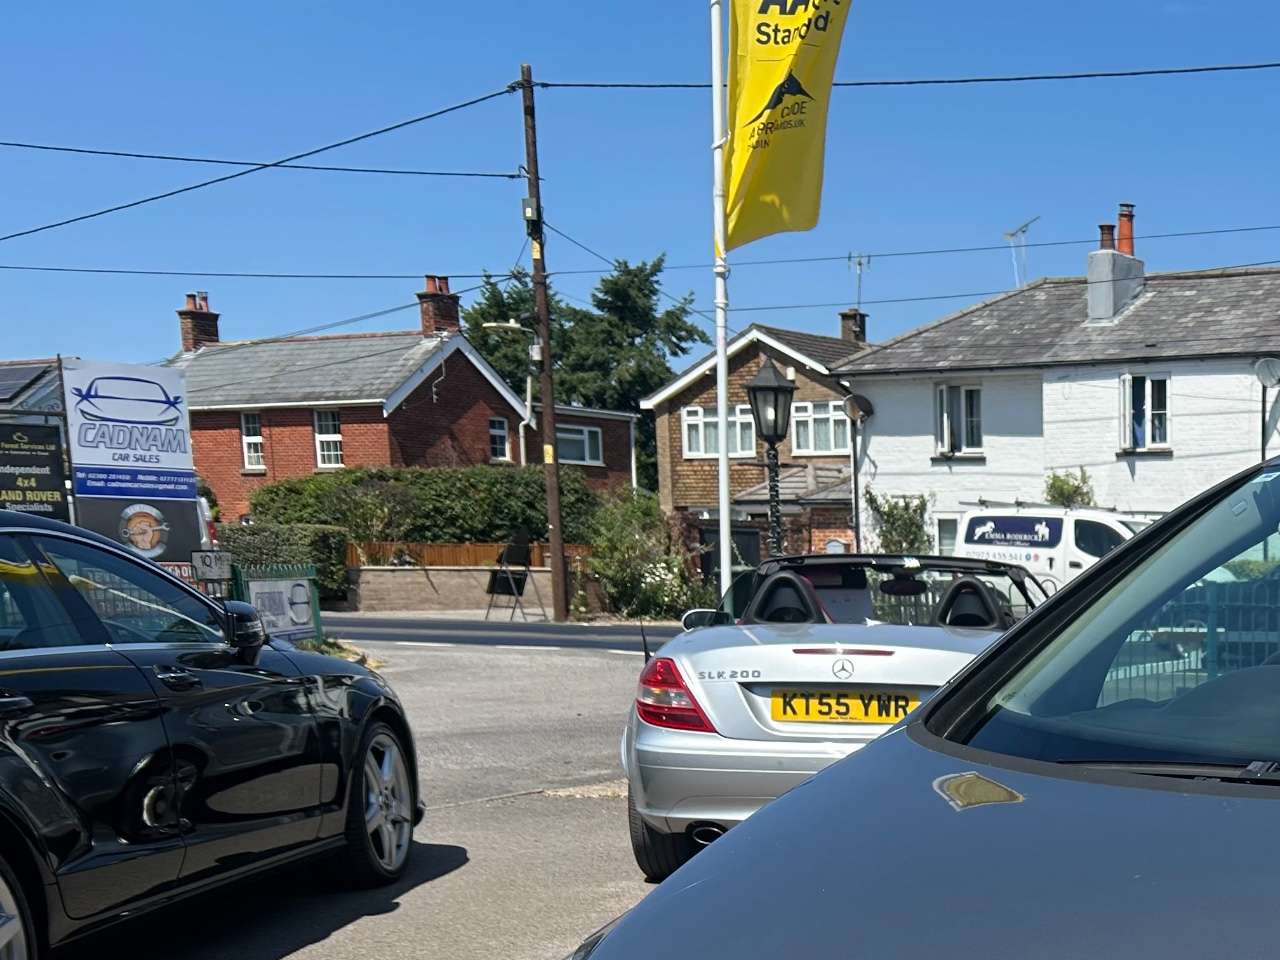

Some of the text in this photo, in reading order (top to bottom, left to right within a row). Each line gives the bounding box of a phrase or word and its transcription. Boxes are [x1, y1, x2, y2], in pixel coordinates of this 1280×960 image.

[77, 422, 188, 454] CADNAM
[112, 452, 161, 464] CAR SALES
[0, 465, 50, 476] ndependent
[16, 477, 37, 488] 4x4
[0, 489, 62, 502] AND ROVER
[6, 502, 54, 512] Specialists
[698, 670, 761, 680] SLK 200
[782, 692, 910, 718] KT55 YWR
